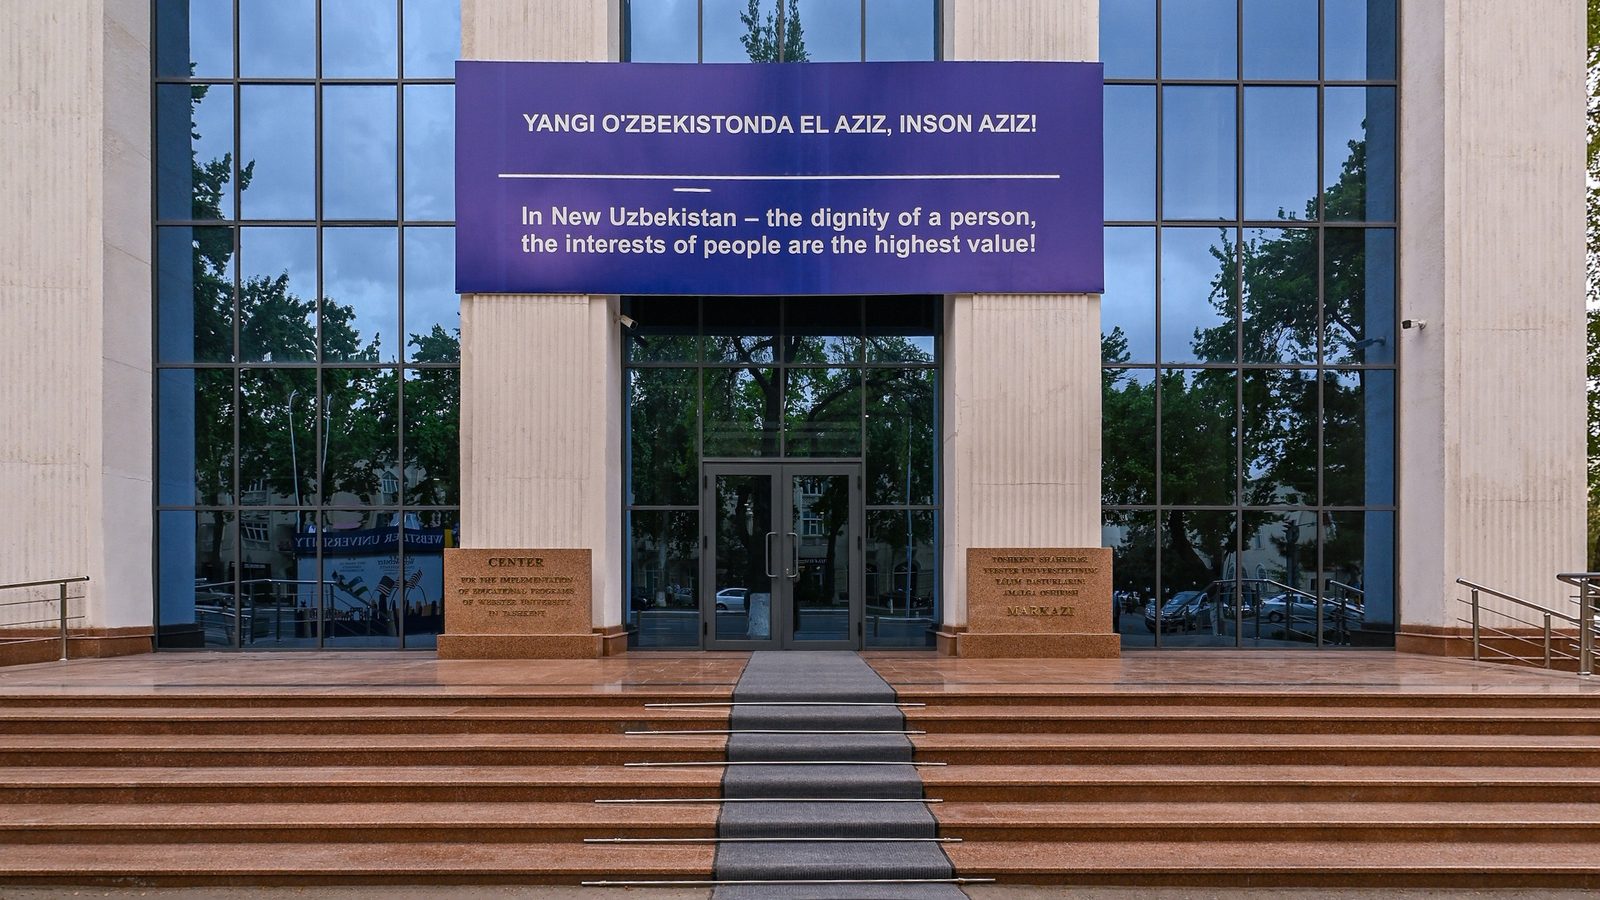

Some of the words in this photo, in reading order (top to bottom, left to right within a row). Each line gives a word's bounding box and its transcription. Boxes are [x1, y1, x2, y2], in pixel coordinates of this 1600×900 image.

[522, 113, 595, 133] YANGI
[602, 114, 795, 134] O'ZBEKISTONDA
[800, 115, 830, 134] EL
[834, 114, 892, 137] AZIZ,
[900, 114, 972, 133] INSON
[978, 114, 1037, 133] AZIZ!
[522, 206, 543, 225] In
[551, 206, 602, 226] New
[609, 206, 737, 227] Uzbekistan
[766, 208, 803, 227] the
[811, 207, 890, 232] dignity
[898, 206, 922, 227] of
[928, 211, 942, 226] a
[950, 206, 1036, 231] person,
[521, 233, 558, 253] the
[565, 233, 666, 254] interests
[673, 234, 698, 254] of
[704, 235, 781, 259] people
[788, 239, 824, 255] are
[830, 234, 867, 254] the
[875, 234, 961, 259] highest
[966, 233, 1036, 253] value!
[488, 557, 545, 568] CENTER
[1007, 606, 1076, 616] MARKAZI
